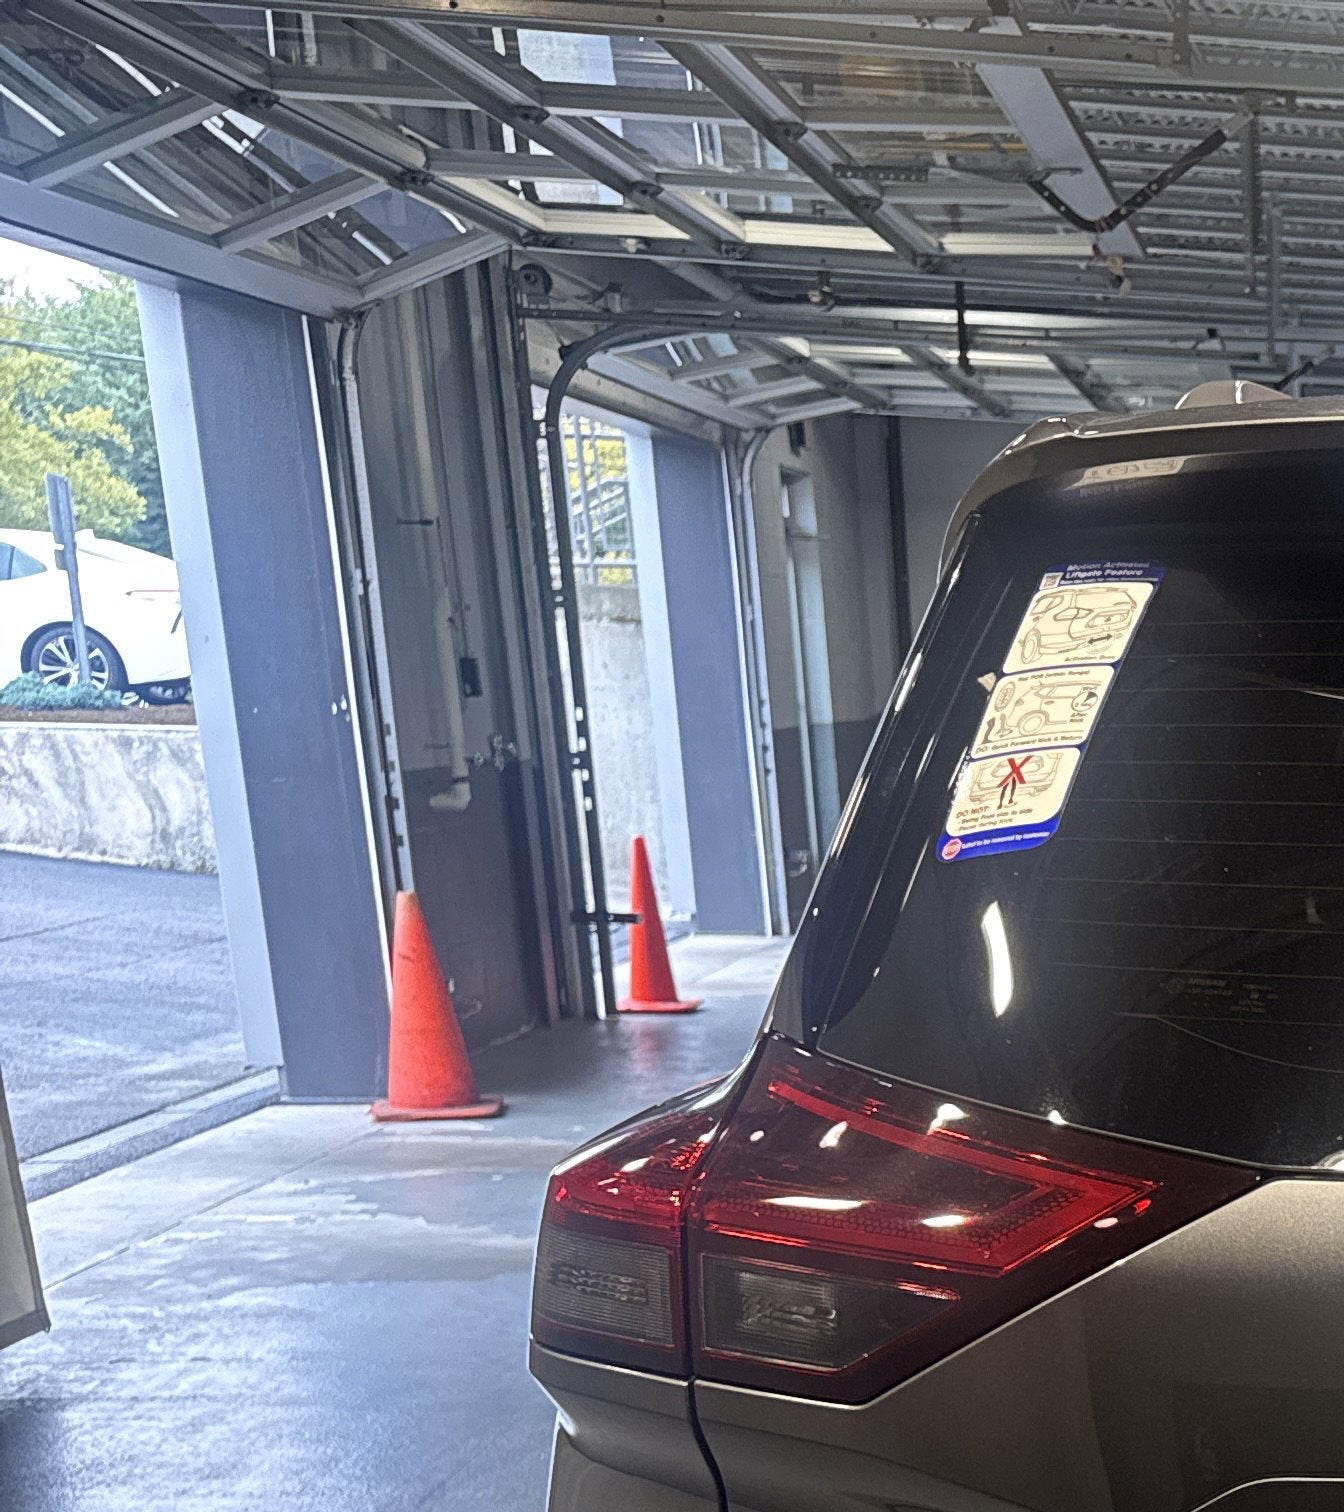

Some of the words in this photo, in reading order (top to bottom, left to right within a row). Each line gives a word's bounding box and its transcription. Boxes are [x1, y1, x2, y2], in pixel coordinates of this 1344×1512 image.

[1067, 563, 1101, 571] Motion
[1065, 569, 1102, 579] Liftgate
[1105, 568, 1143, 576] Feature
[991, 742, 1009, 750] Quick
[1010, 739, 1037, 747] Forward
[956, 809, 969, 818] DO
